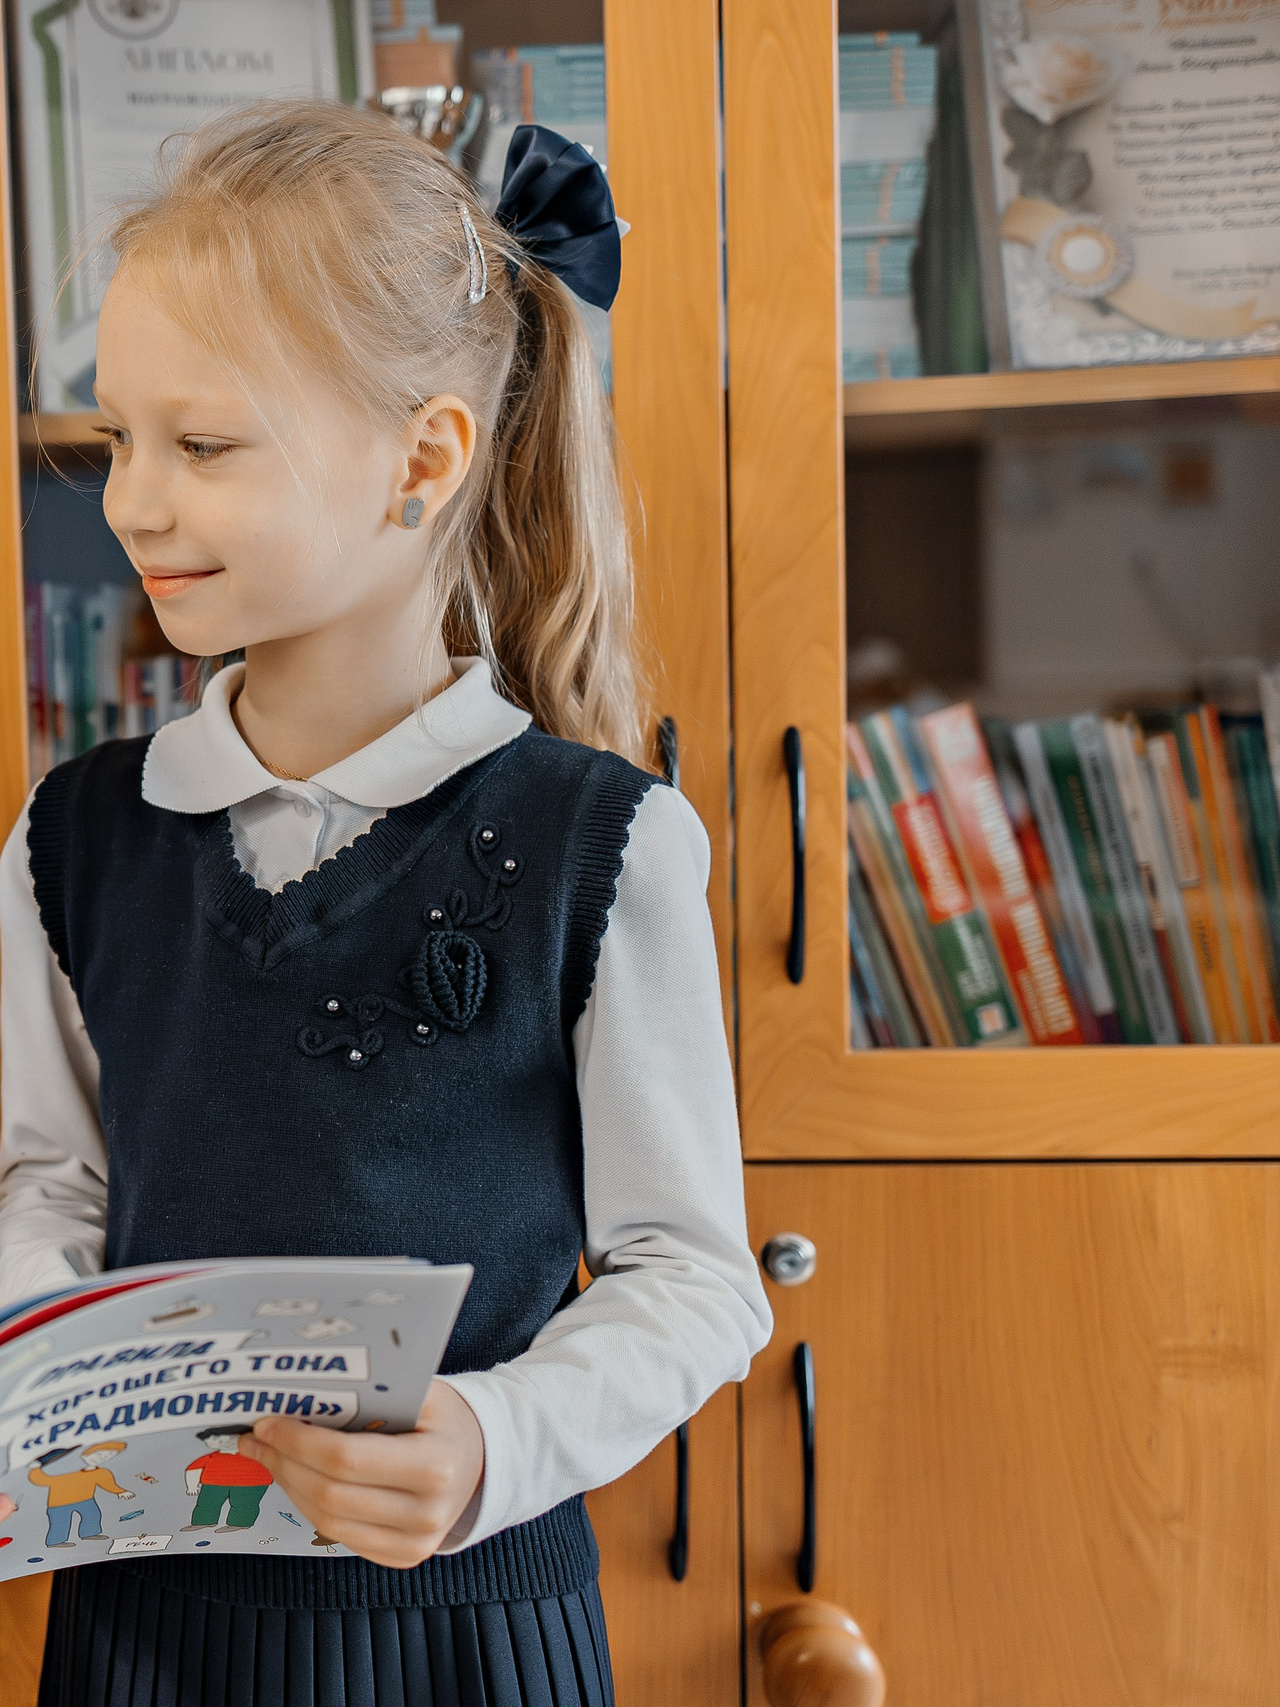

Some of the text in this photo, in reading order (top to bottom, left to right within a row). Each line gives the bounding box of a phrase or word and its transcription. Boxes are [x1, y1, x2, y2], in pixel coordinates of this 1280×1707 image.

[22, 1391, 343, 1449] «РАДИОНЯНИ»
[26, 1355, 349, 1427] ХОРОШЕГО ТОНА
